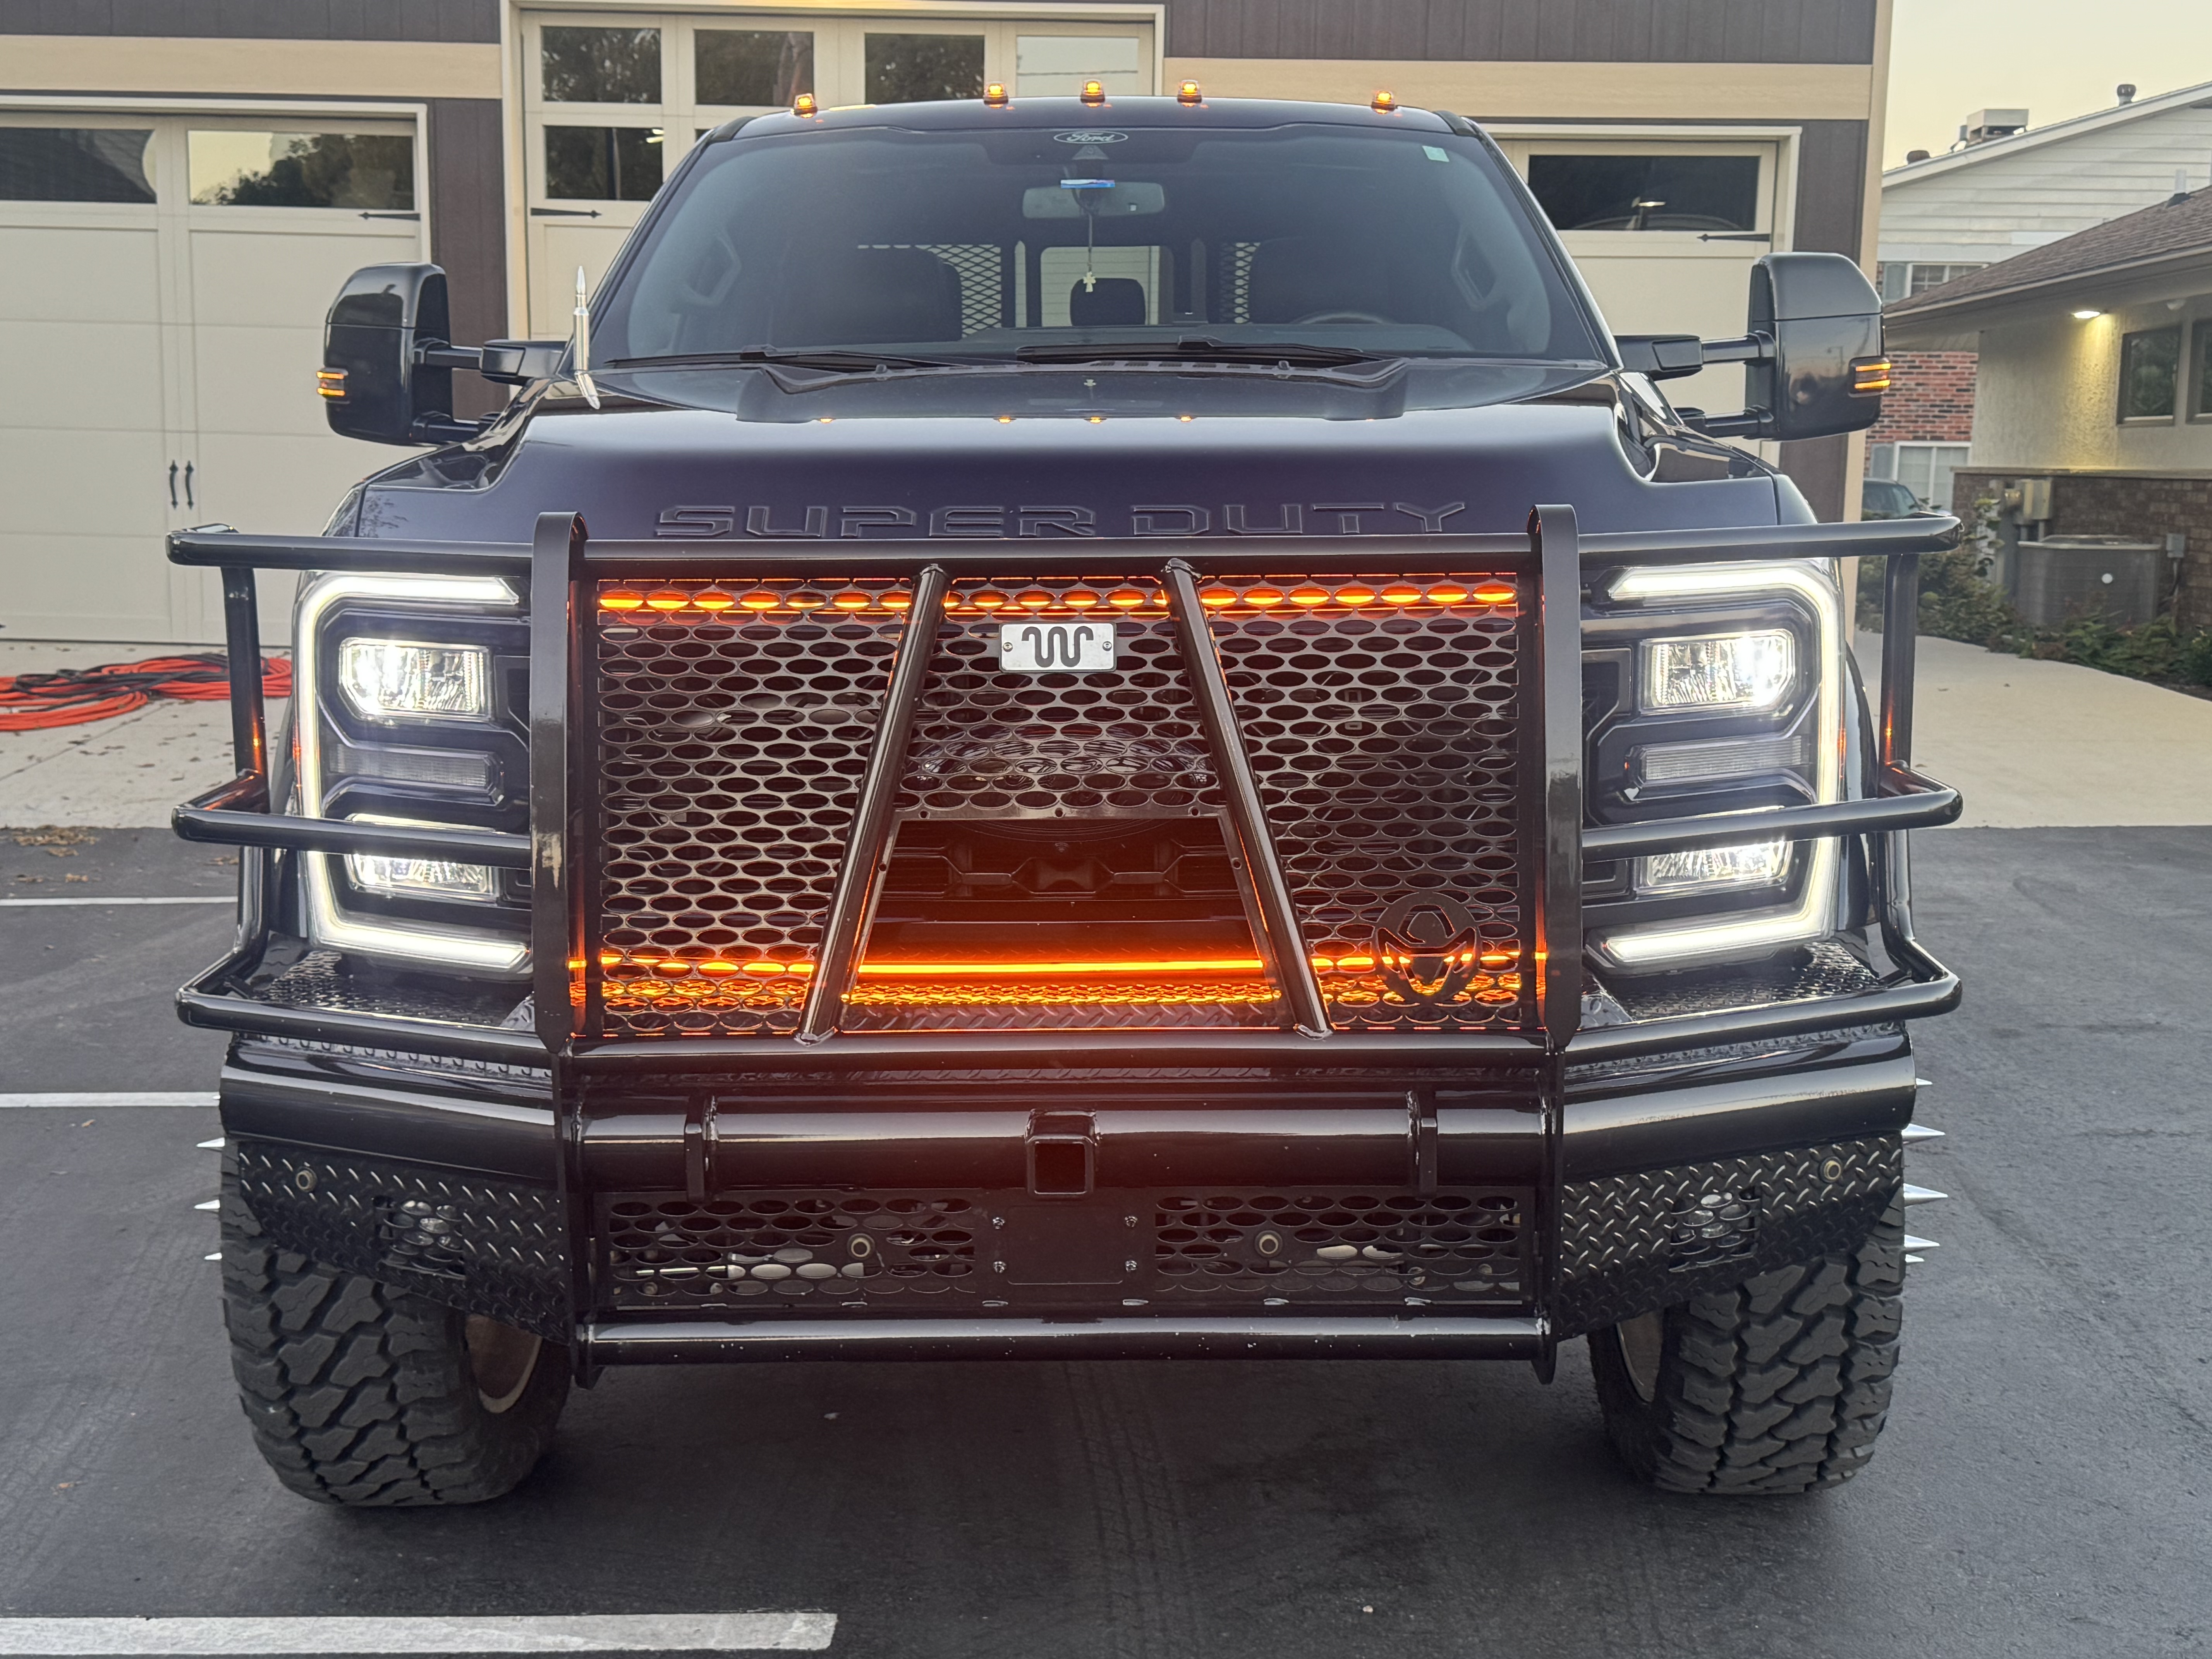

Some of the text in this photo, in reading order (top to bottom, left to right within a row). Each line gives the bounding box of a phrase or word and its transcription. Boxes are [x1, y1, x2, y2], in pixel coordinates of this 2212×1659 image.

[1066, 132, 1115, 142] Ford
[656, 502, 1465, 537] SUPER DUTY
